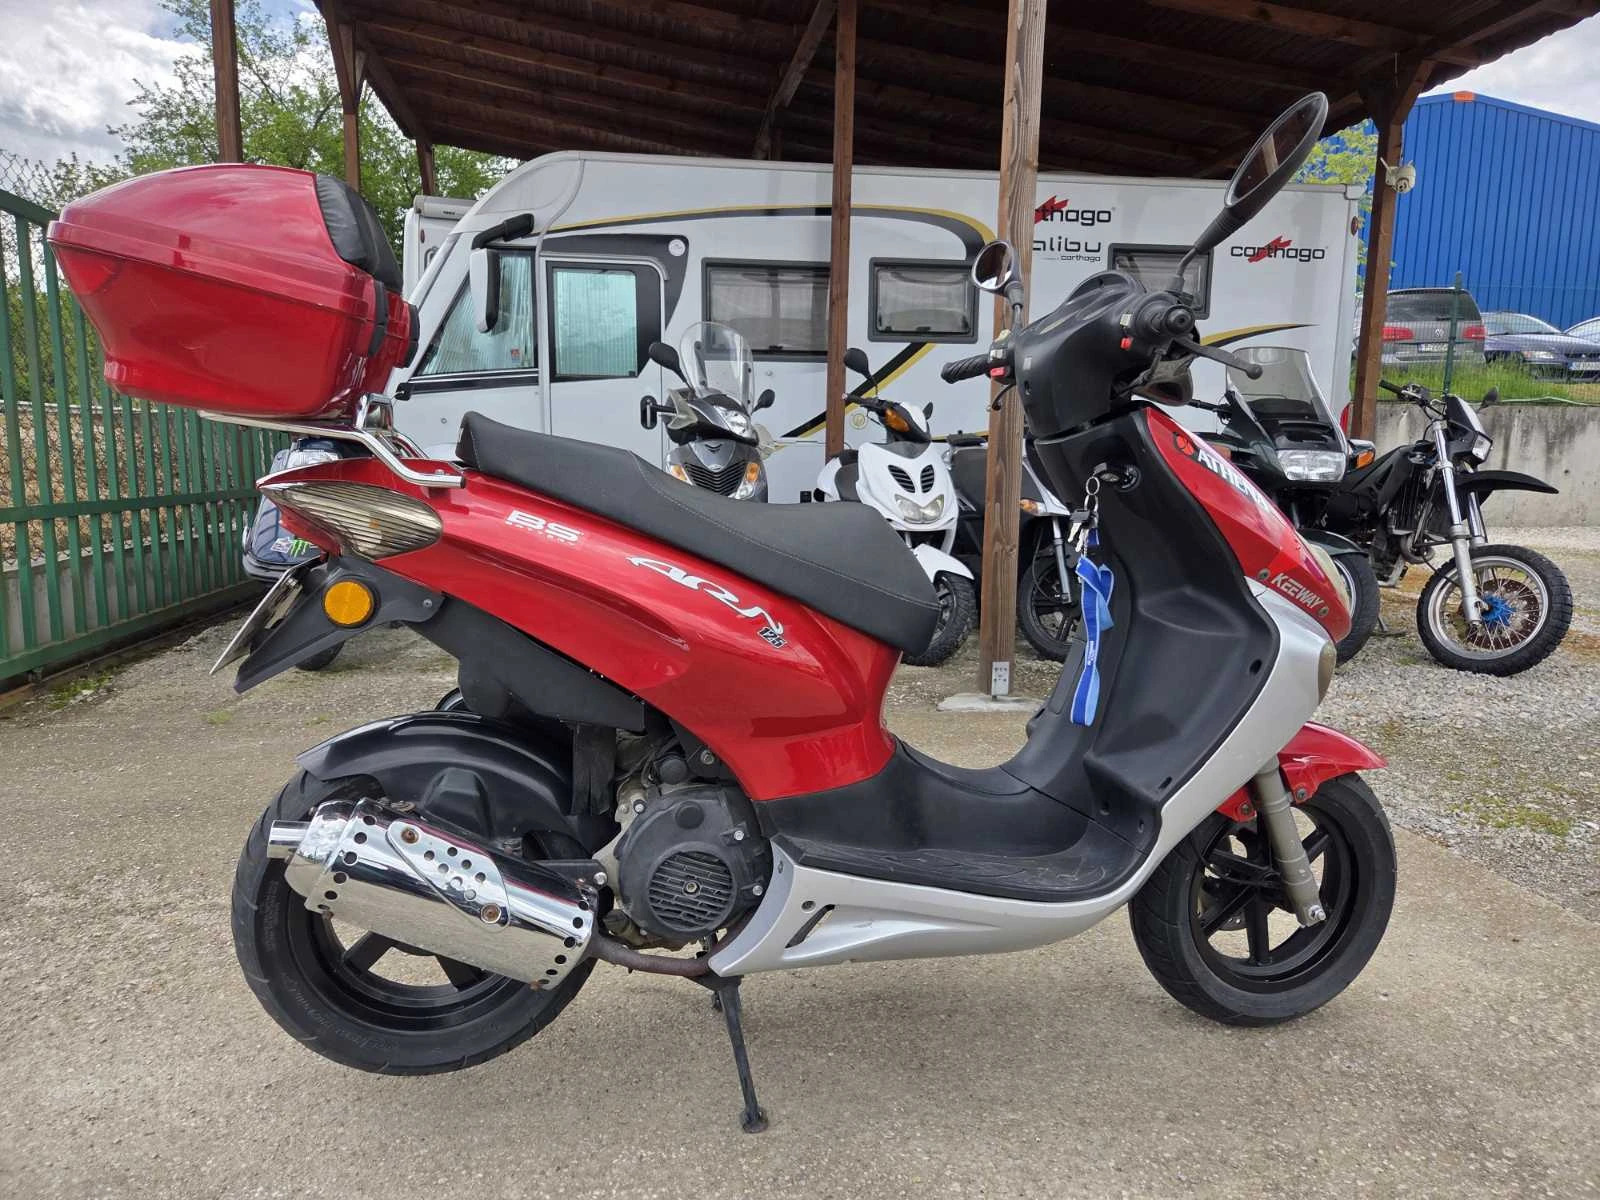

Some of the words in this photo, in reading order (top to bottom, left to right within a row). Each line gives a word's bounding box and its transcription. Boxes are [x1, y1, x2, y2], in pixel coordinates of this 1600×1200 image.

[1060, 255, 1101, 263] carthago
[1230, 244, 1325, 262] carthago
[506, 510, 585, 541] BS
[1271, 572, 1325, 609] KEEWAY
[757, 627, 787, 649] 125
